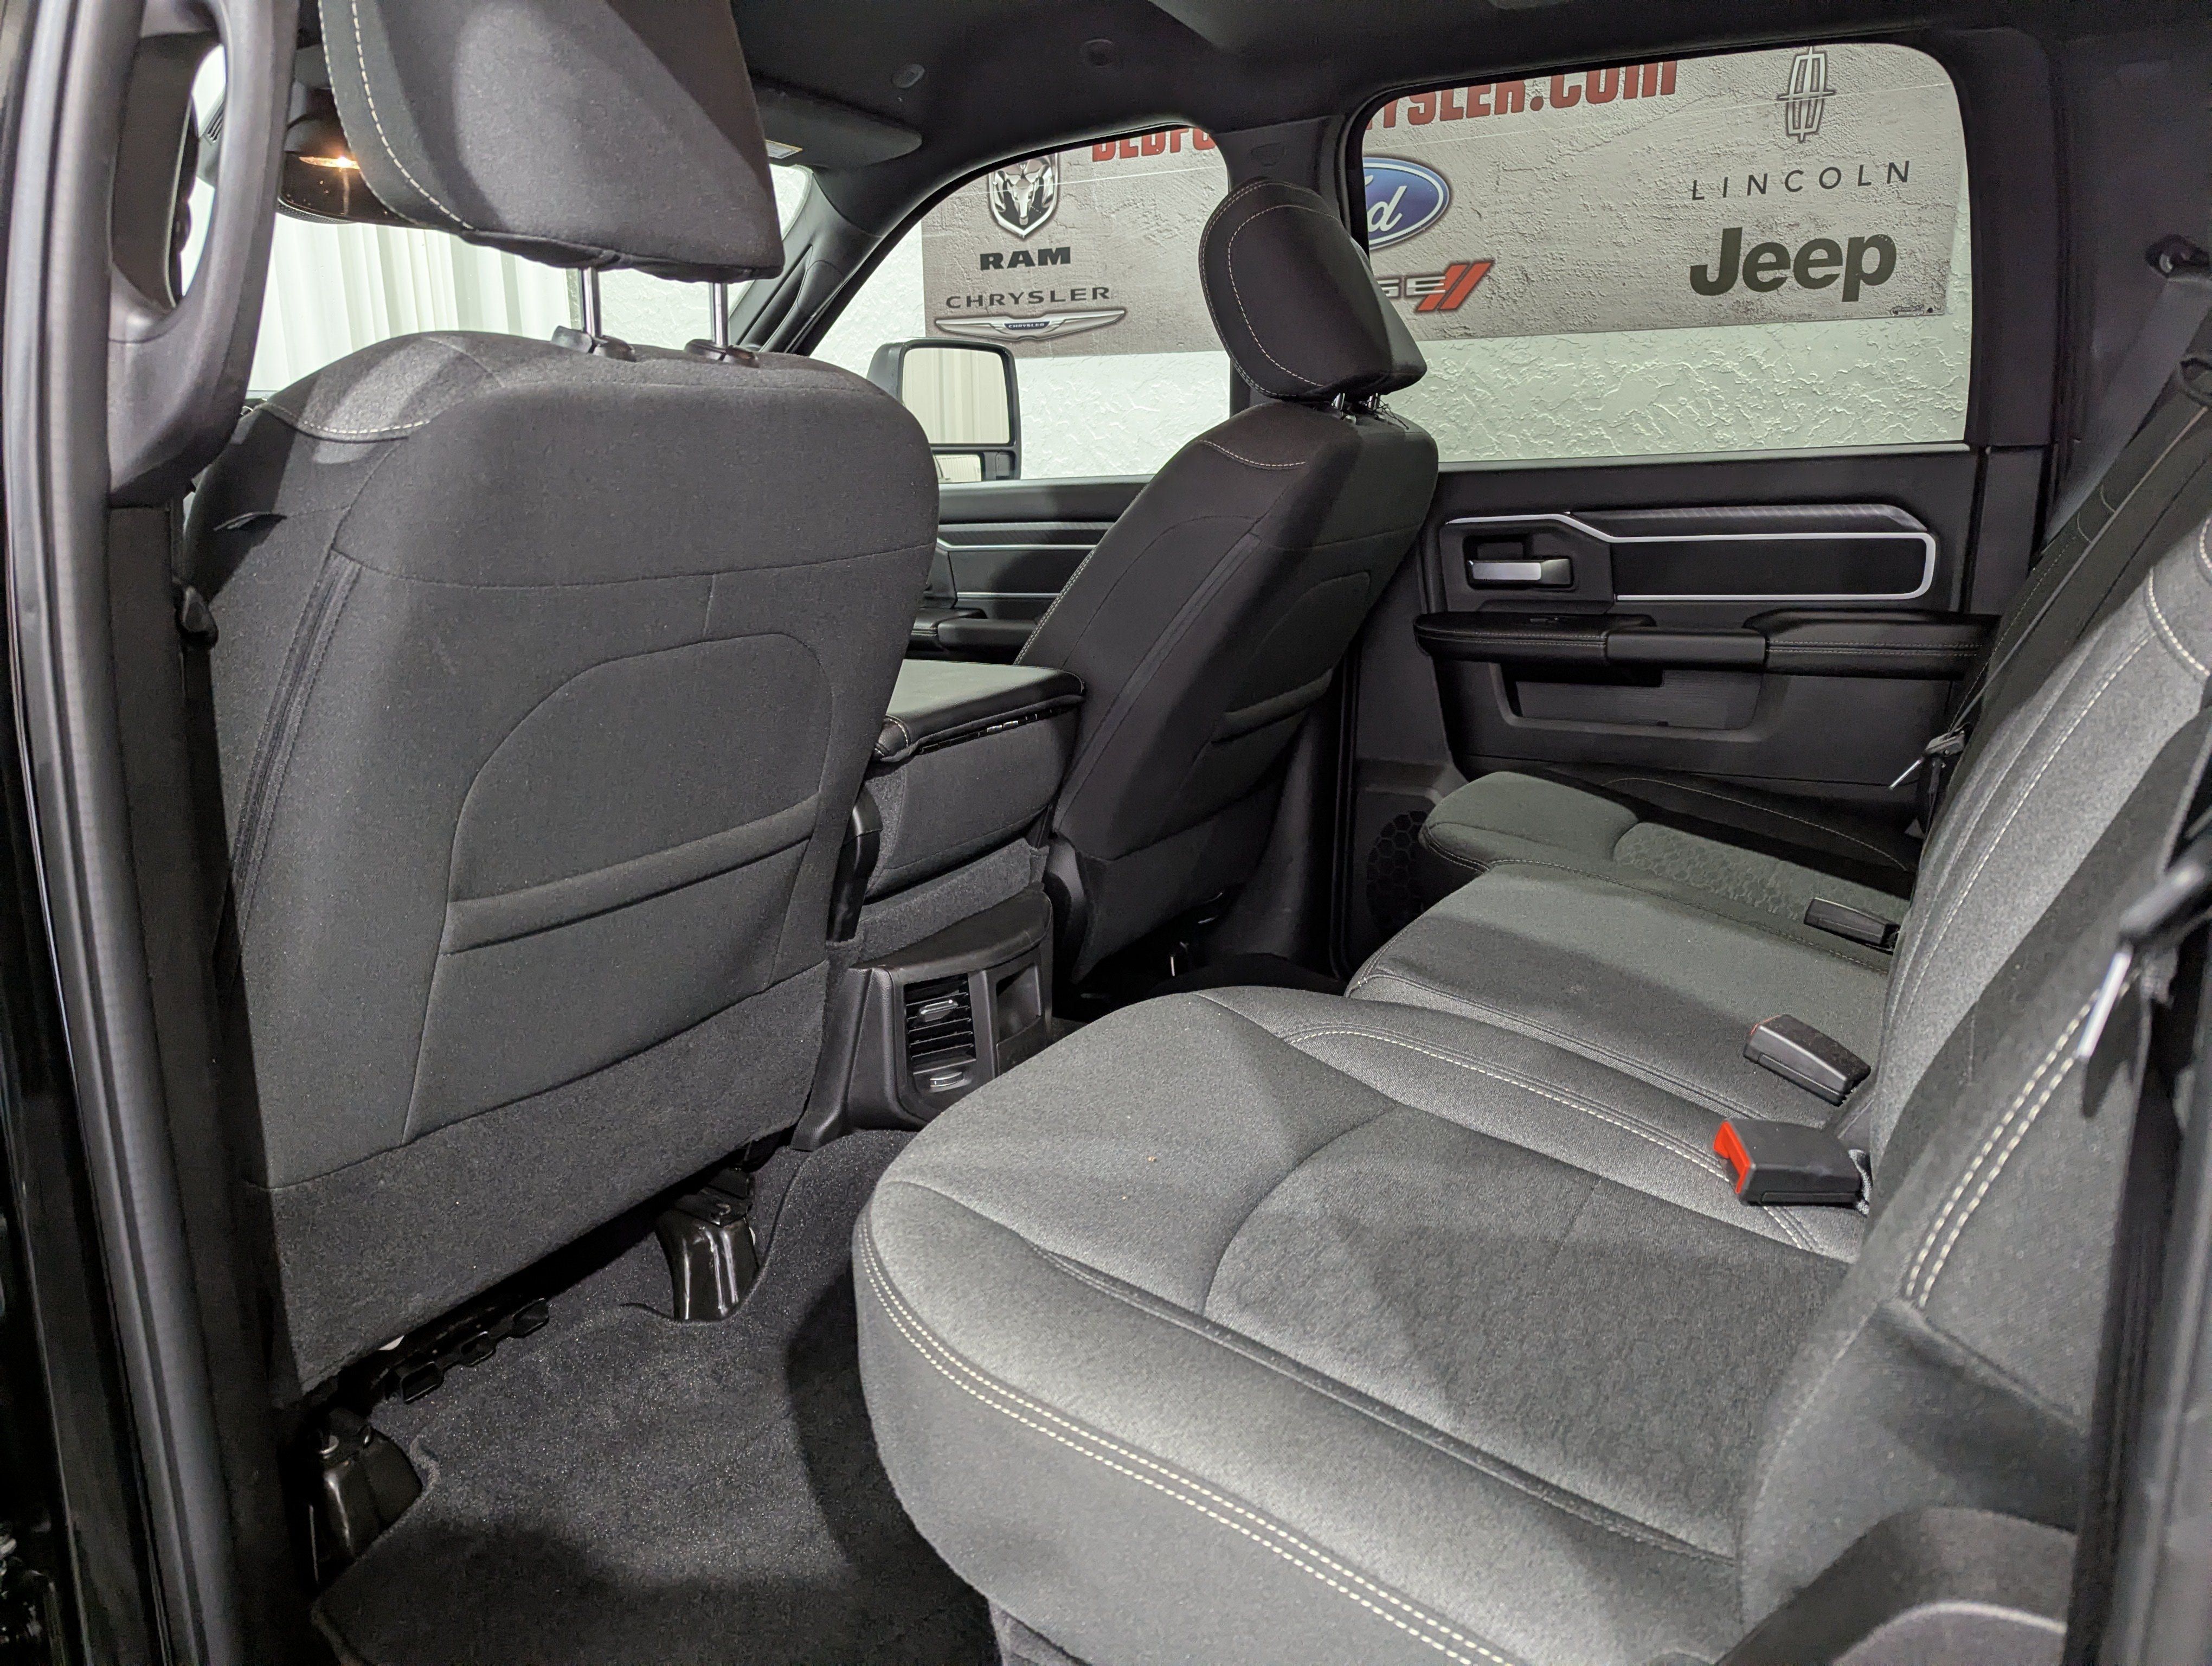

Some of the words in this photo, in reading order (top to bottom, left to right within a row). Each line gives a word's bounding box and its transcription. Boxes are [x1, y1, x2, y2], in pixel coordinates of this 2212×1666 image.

[1692, 161, 1909, 200] LINCOLN
[980, 247, 1070, 270] RAM
[1690, 227, 1897, 302] Jeep
[946, 287, 1110, 309] CHRYSLER
